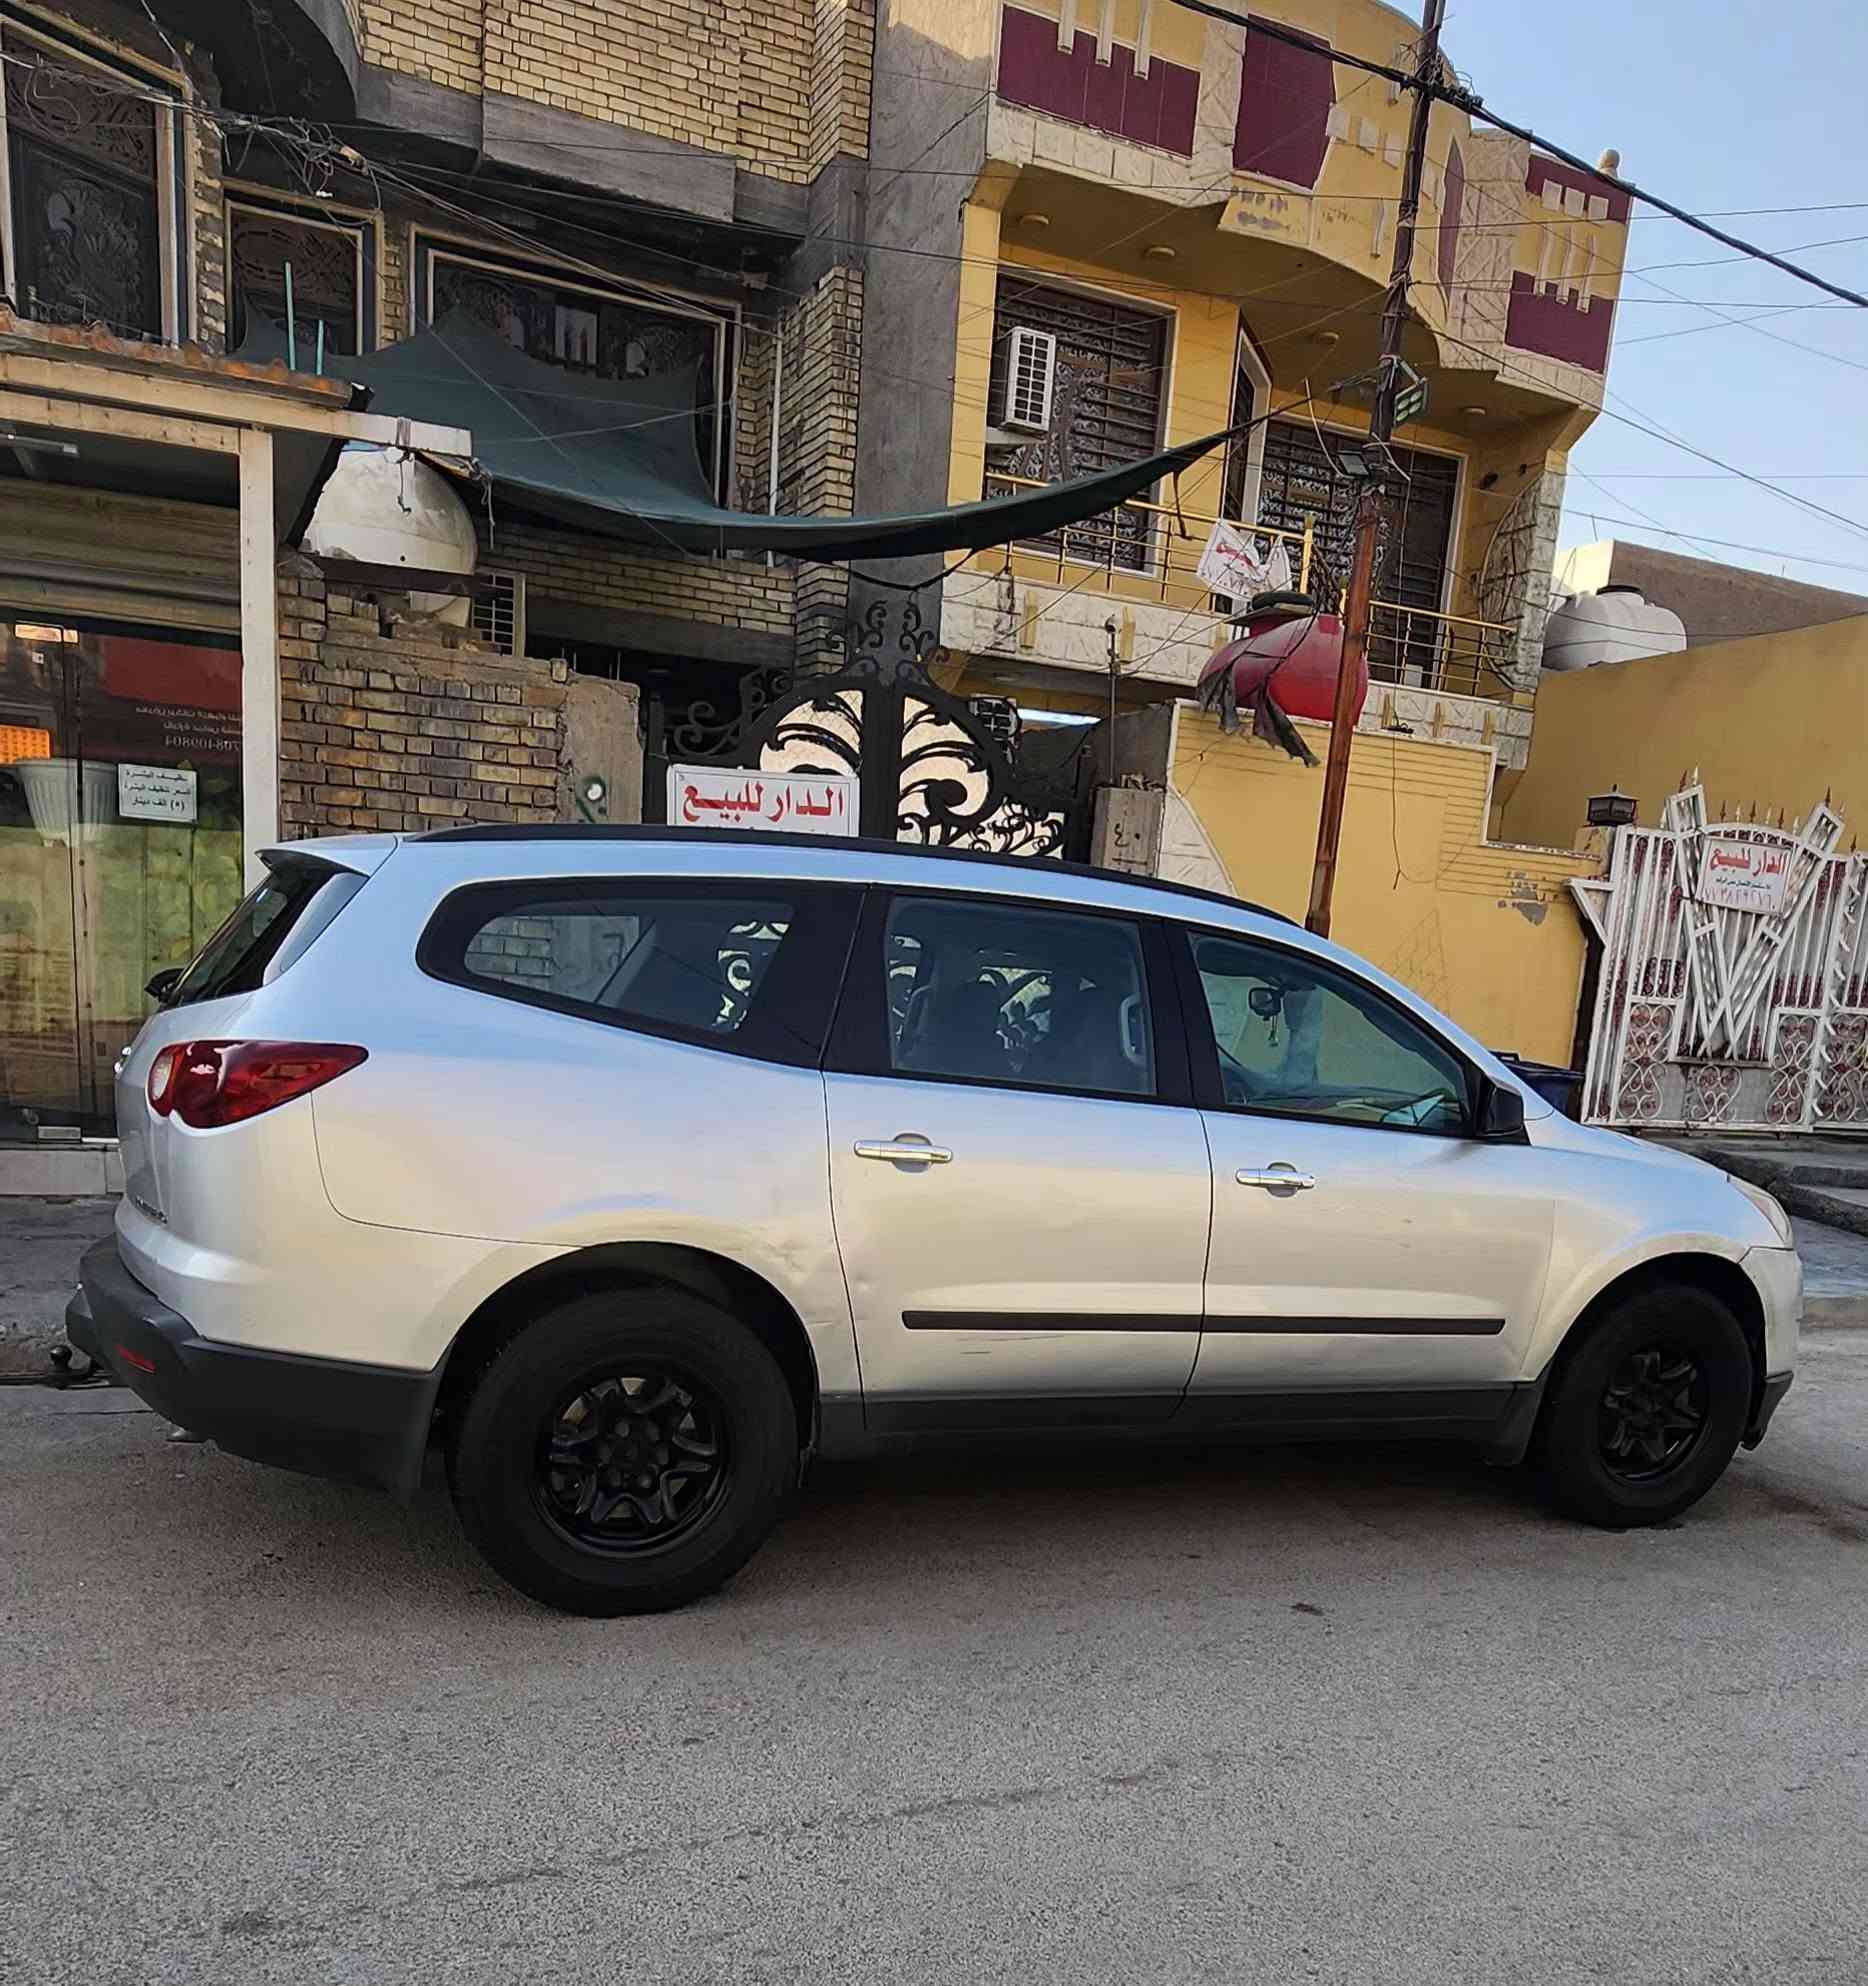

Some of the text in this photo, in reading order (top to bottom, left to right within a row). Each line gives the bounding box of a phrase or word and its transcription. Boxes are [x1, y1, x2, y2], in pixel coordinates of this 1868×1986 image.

[682, 780, 843, 823] الدار للبيع
[1710, 847, 1788, 877] الدار للبيع
